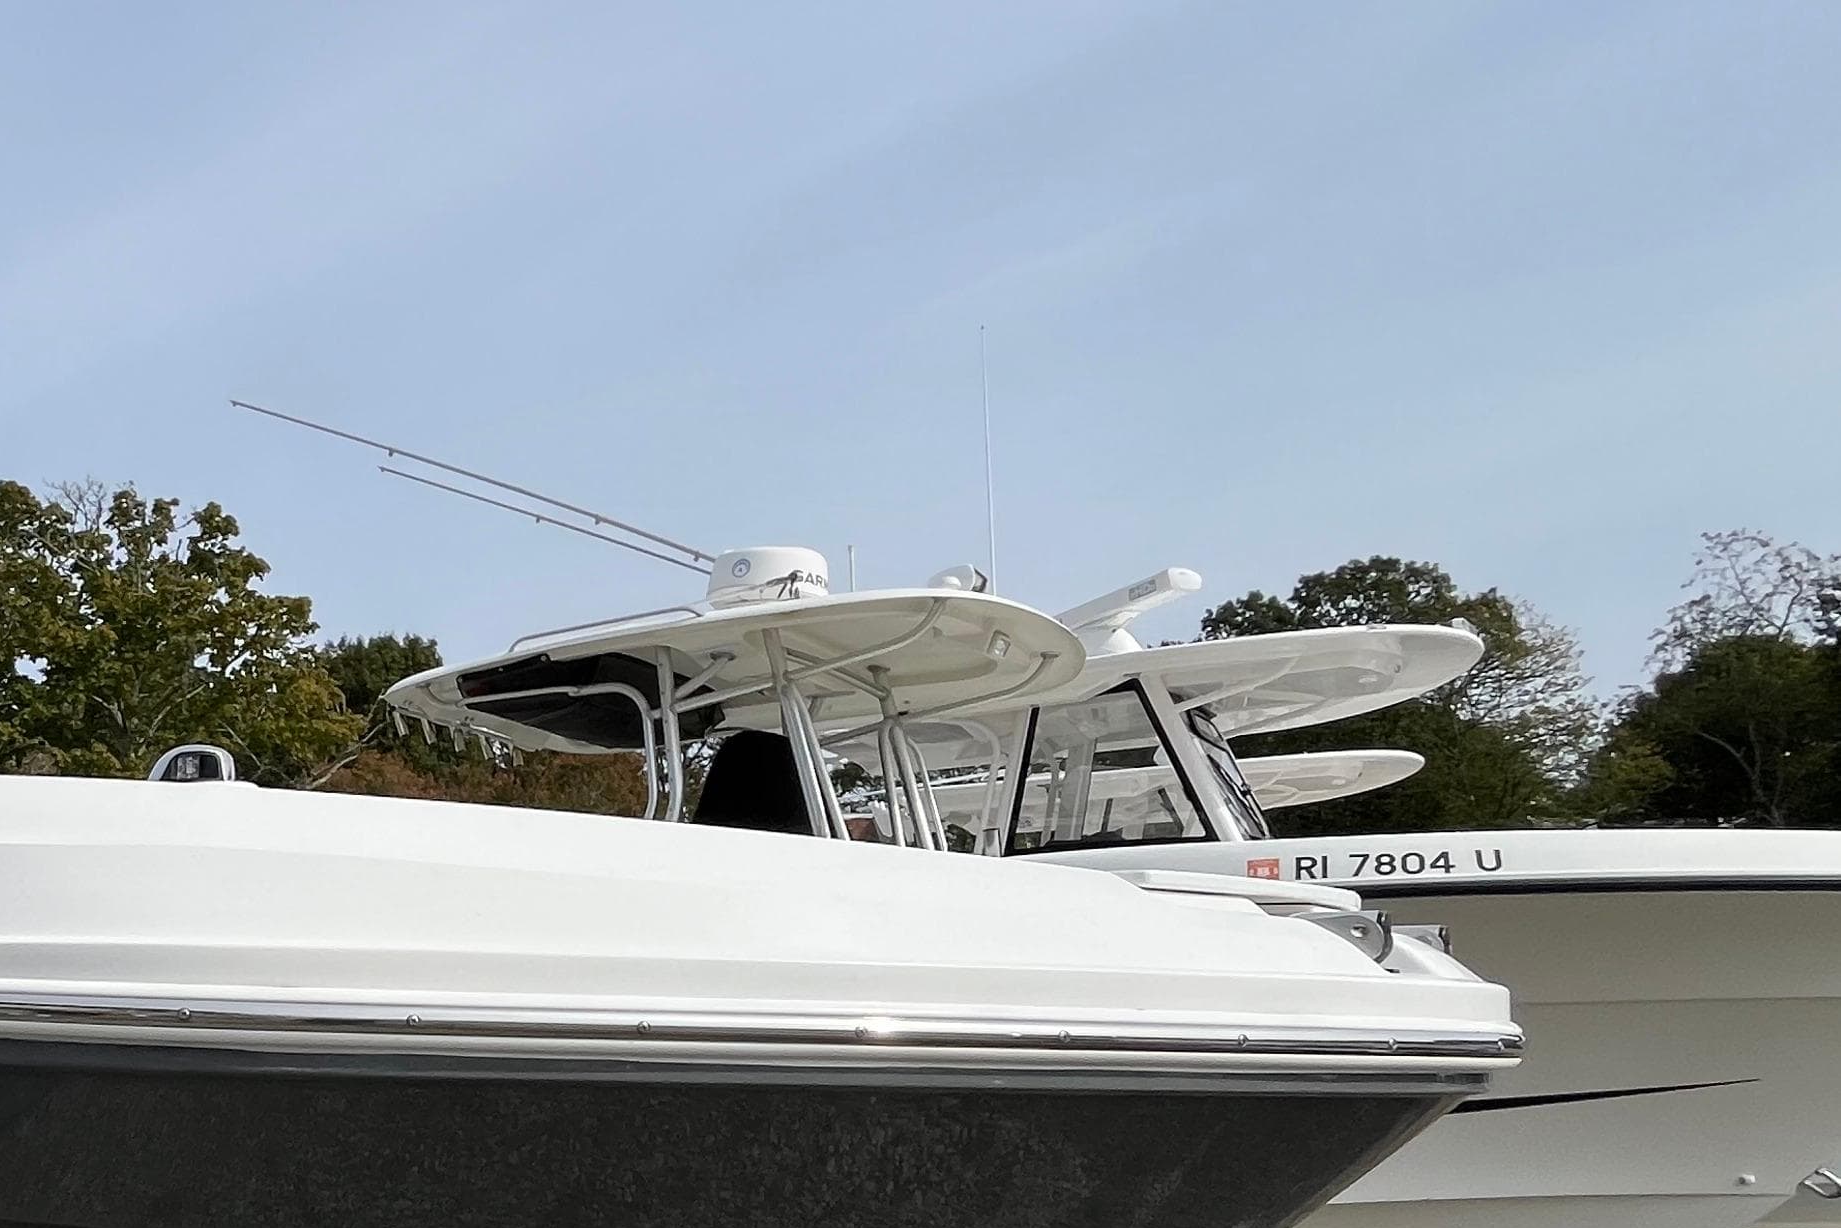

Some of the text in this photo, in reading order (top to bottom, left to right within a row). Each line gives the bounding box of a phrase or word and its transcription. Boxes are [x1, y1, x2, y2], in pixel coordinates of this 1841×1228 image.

[1294, 855, 1328, 881] RI
[1349, 851, 1456, 878] 7804
[1475, 849, 1503, 872] U
